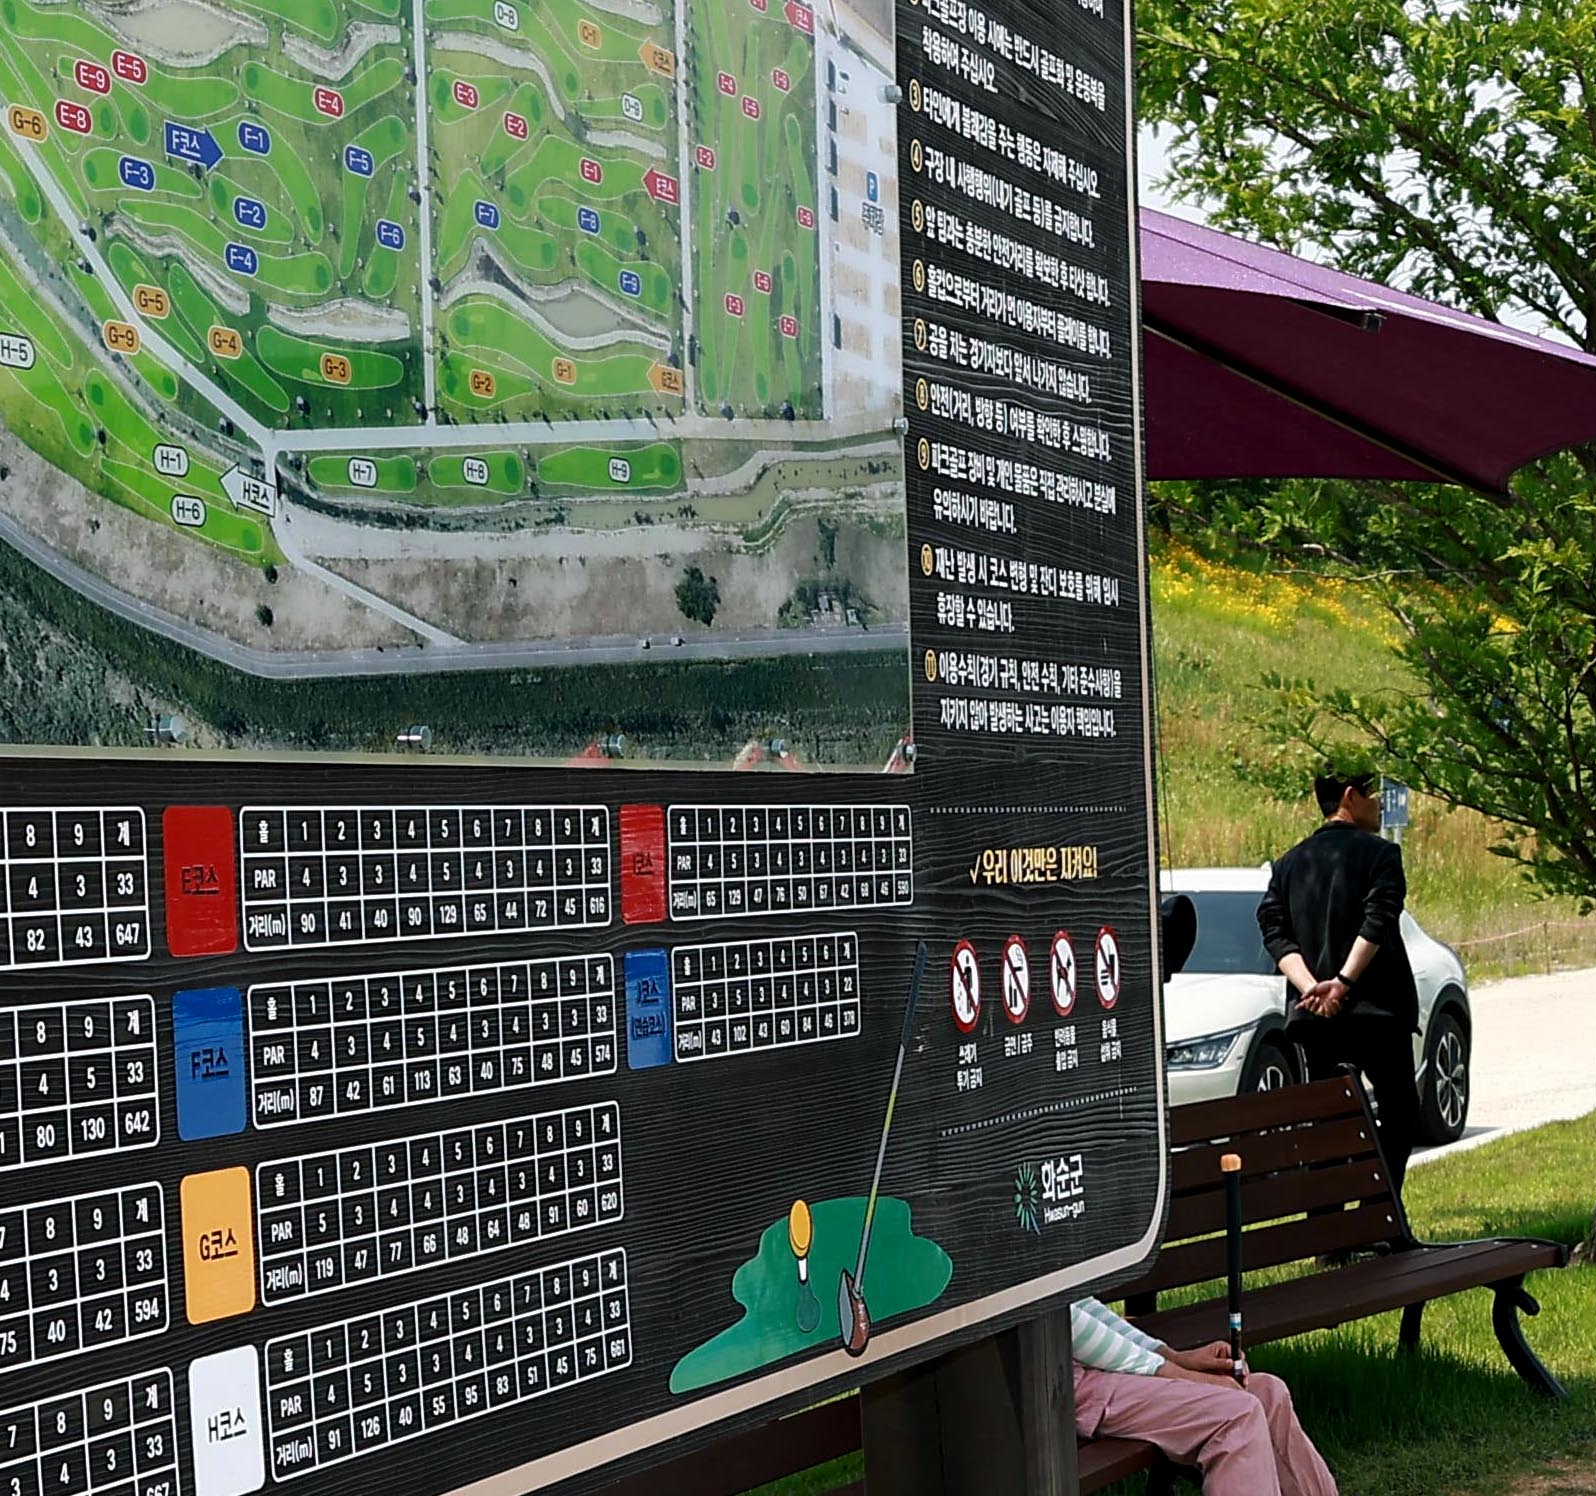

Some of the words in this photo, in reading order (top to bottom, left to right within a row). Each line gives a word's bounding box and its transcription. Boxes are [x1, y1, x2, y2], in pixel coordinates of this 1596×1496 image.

[79, 64, 105, 89] E-9
[117, 55, 141, 79] E-5
[318, 91, 340, 113] E-4
[457, 85, 475, 104] E-3
[13, 110, 41, 135] G-6
[60, 105, 87, 129] E-8
[507, 115, 525, 135] E-2
[923, 86, 960, 133] 타인에게
[998, 123, 1015, 159] 주는
[1016, 132, 1041, 172] 행동은
[172, 130, 201, 158] F코스
[244, 128, 264, 149] F-1
[124, 162, 149, 184] F-3
[349, 150, 369, 171] F-5
[583, 162, 599, 180] E-1
[239, 202, 261, 224] F-2
[478, 205, 495, 224] F-7
[381, 225, 400, 245] F-6
[230, 249, 252, 269] F-4
[937, 210, 964, 250] 팀과는
[965, 221, 992, 261] 충분한
[1034, 250, 1059, 287] 확보한
[1059, 260, 1069, 291] 후
[139, 290, 164, 312] G-5
[108, 326, 135, 347] G-9
[213, 332, 237, 351] G-4
[0, 339, 28, 362] H-5
[324, 359, 346, 377] G-3
[556, 362, 572, 380] G-1
[473, 376, 492, 392] G-2
[975, 396, 993, 430] 방향
[1009, 407, 1035, 442] 여부를
[1036, 412, 1061, 448] 확인한
[1062, 420, 1071, 450] 후
[161, 450, 182, 470] H-1
[352, 463, 373, 481] H-7
[466, 462, 485, 480] H-8
[611, 462, 628, 479] H-9
[243, 481, 270, 509] H코스
[176, 500, 200, 520] H-6
[935, 547, 954, 580] 재난
[956, 550, 976, 584] 발생
[978, 555, 987, 586] 시
[989, 557, 1008, 587] 코스
[1029, 564, 1038, 594] 및
[1039, 566, 1057, 597] 잔디
[1059, 569, 1083, 601] 보호를
[1085, 574, 1101, 604] 위해
[1102, 577, 1119, 606] 임시
[936, 591, 965, 627] 휴장할
[966, 597, 976, 628] 수
[1021, 661, 1039, 691] 안전
[1061, 664, 1079, 694] 기타
[940, 697, 968, 730] 지키지
[989, 701, 1023, 732] 발생하는
[1024, 703, 1050, 734] 사고는
[1050, 705, 1075, 735] 이용자
[26, 824, 35, 847] 8
[74, 824, 83, 846] 9
[117, 821, 130, 846] 계
[982, 849, 1008, 885] 우리
[1010, 847, 1058, 883] 이것만은
[1060, 846, 1097, 880] 지켜요!
[28, 877, 38, 898] 4
[76, 874, 86, 897] 3
[117, 873, 134, 895] 33
[181, 865, 220, 895] E코스
[249, 913, 286, 937] 거리(m)
[301, 913, 316, 933] 90
[339, 911, 351, 930] 41
[374, 909, 388, 928] 40
[408, 907, 422, 926] 90
[440, 905, 457, 924] 129
[474, 903, 487, 922] 65
[505, 902, 518, 919] 44
[535, 900, 547, 917] 72
[564, 898, 576, 915] 45
[590, 896, 605, 914] 616
[27, 929, 45, 951] 82
[75, 926, 93, 947] 43
[116, 923, 140, 945] 647
[36, 1021, 46, 1043] 8
[84, 1016, 93, 1038] 9
[127, 1009, 140, 1035] 계
[191, 1047, 229, 1080] F코스
[38, 1073, 49, 1095] 4
[87, 1067, 96, 1089] 5
[127, 1061, 144, 1083] 33
[36, 1124, 55, 1148] 80
[81, 1117, 105, 1141] 130
[125, 1110, 150, 1134] 642
[1041, 1154, 1084, 1202] 화순군
[46, 1217, 55, 1239] 8
[93, 1208, 102, 1230] 9
[136, 1197, 148, 1222] 계
[1044, 1200, 1085, 1224] Hwasun-gun
[200, 1228, 238, 1260] G코스
[48, 1269, 58, 1291] 3
[96, 1259, 105, 1280] 3
[136, 1249, 153, 1271] 33
[47, 1319, 66, 1343] 40
[95, 1308, 113, 1331] 42
[135, 1297, 159, 1322] 594
[8, 1425, 17, 1448] 7
[57, 1411, 66, 1434] 8
[104, 1399, 113, 1420] 9
[146, 1384, 158, 1409] 계
[207, 1408, 247, 1444] H코스
[60, 1463, 70, 1484] 4
[107, 1449, 116, 1471] 3
[146, 1435, 163, 1458] 33
